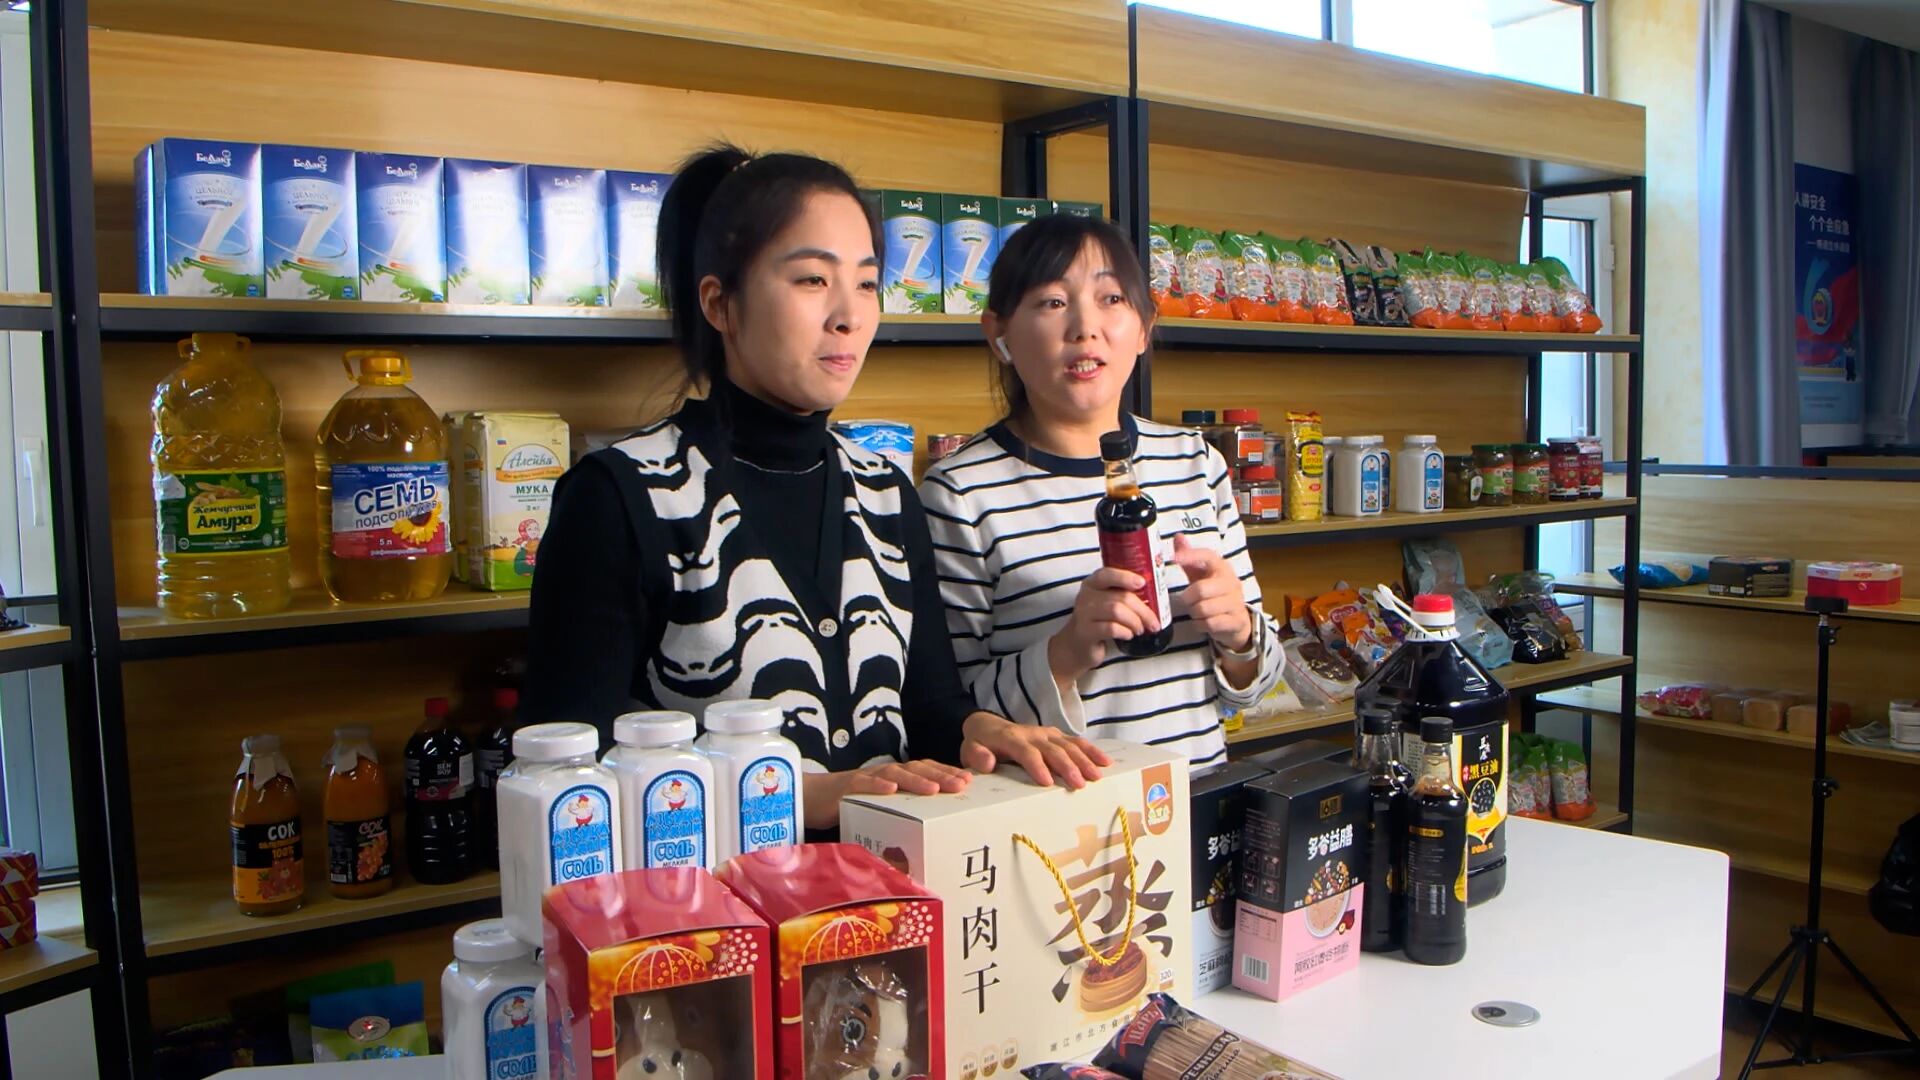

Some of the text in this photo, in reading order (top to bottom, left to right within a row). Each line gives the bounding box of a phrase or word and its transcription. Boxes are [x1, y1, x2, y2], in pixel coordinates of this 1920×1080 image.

[354, 476, 436, 515] СЕМЬ
[516, 485, 549, 495] МУКА
[196, 515, 253, 532] Амура
[267, 821, 295, 841] СОК
[750, 823, 788, 845] СОЛЬ
[1308, 823, 1354, 861] 多谷益膳
[654, 839, 695, 862] СОЛЬ
[562, 855, 604, 880] СОЛЬ
[960, 845, 1001, 1014] 马肉干
